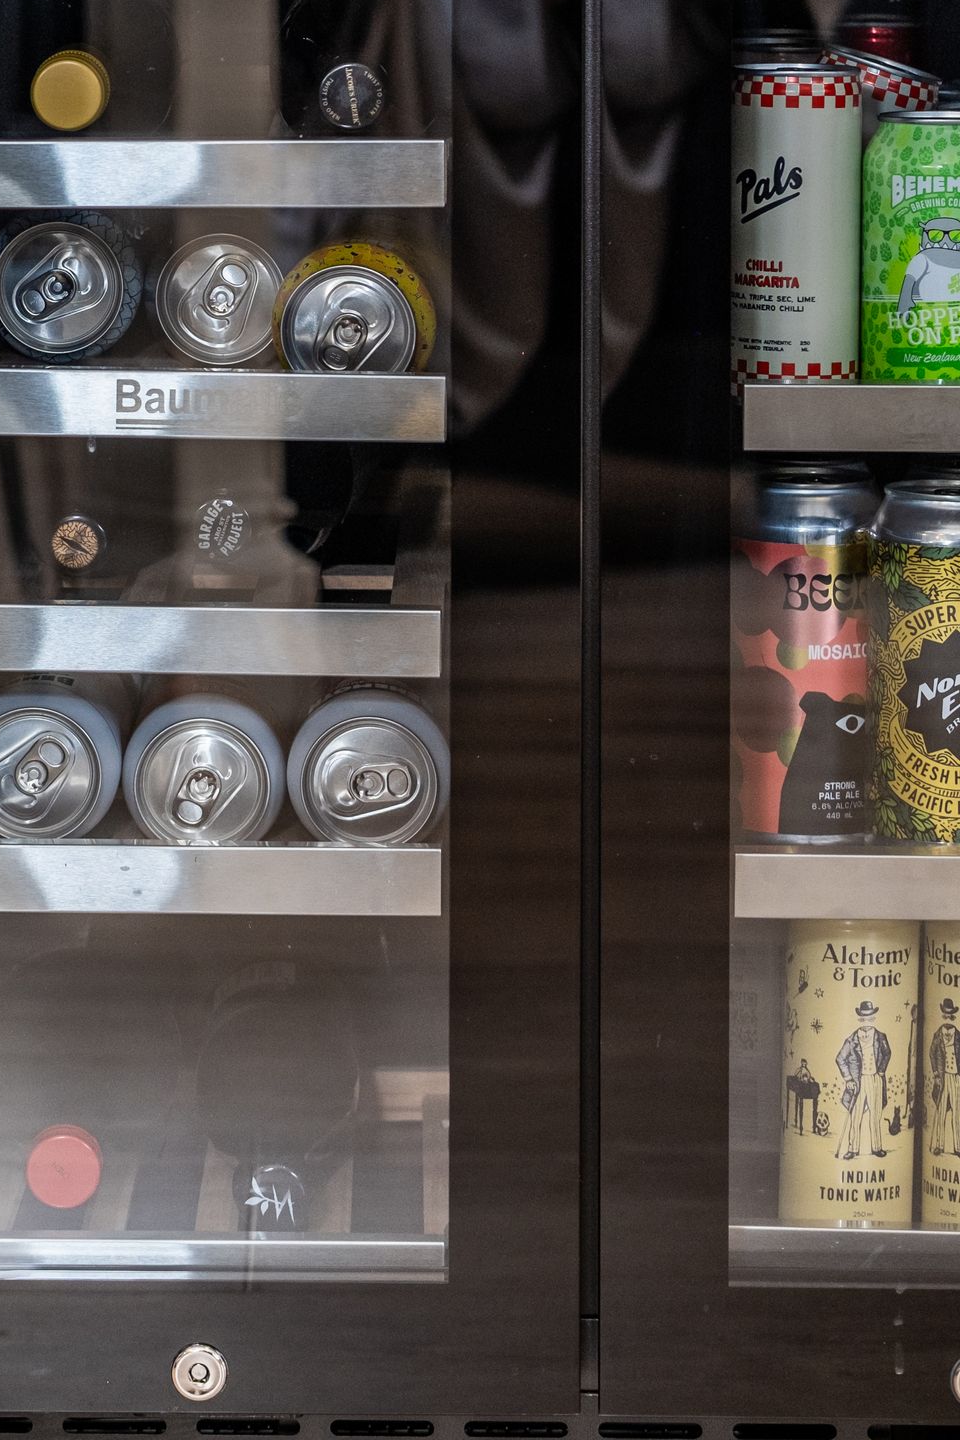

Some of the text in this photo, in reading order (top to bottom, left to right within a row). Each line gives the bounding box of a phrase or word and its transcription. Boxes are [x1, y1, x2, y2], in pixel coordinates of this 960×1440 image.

[321, 78, 341, 121] TWIST TO OPEN
[363, 70, 383, 116] TWIST TO OPEN
[350, 97, 359, 124] CREEK
[736, 156, 803, 215] Pals
[910, 197, 960, 212] BREWING CO
[745, 259, 783, 273] CHILLI
[734, 273, 800, 289] MARGARITA
[749, 293, 773, 302] TRIPLE
[776, 295, 794, 303] SEC,
[908, 327, 942, 345] ON
[903, 353, 923, 363] New
[198, 499, 223, 550] GARAGE
[220, 512, 243, 557] PROJECT
[905, 605, 957, 636] SUPER
[905, 752, 950, 785] FRESH
[819, 790, 860, 801] PALE ALE
[824, 781, 856, 791] STRONG
[901, 782, 953, 814] PACIFIC
[822, 943, 911, 965] Alchemy
[833, 967, 901, 988] & Tonic
[842, 1169, 885, 1183] INDIAN
[820, 1185, 900, 1202] TONIC WATER
[923, 1179, 944, 1200] TONIC
